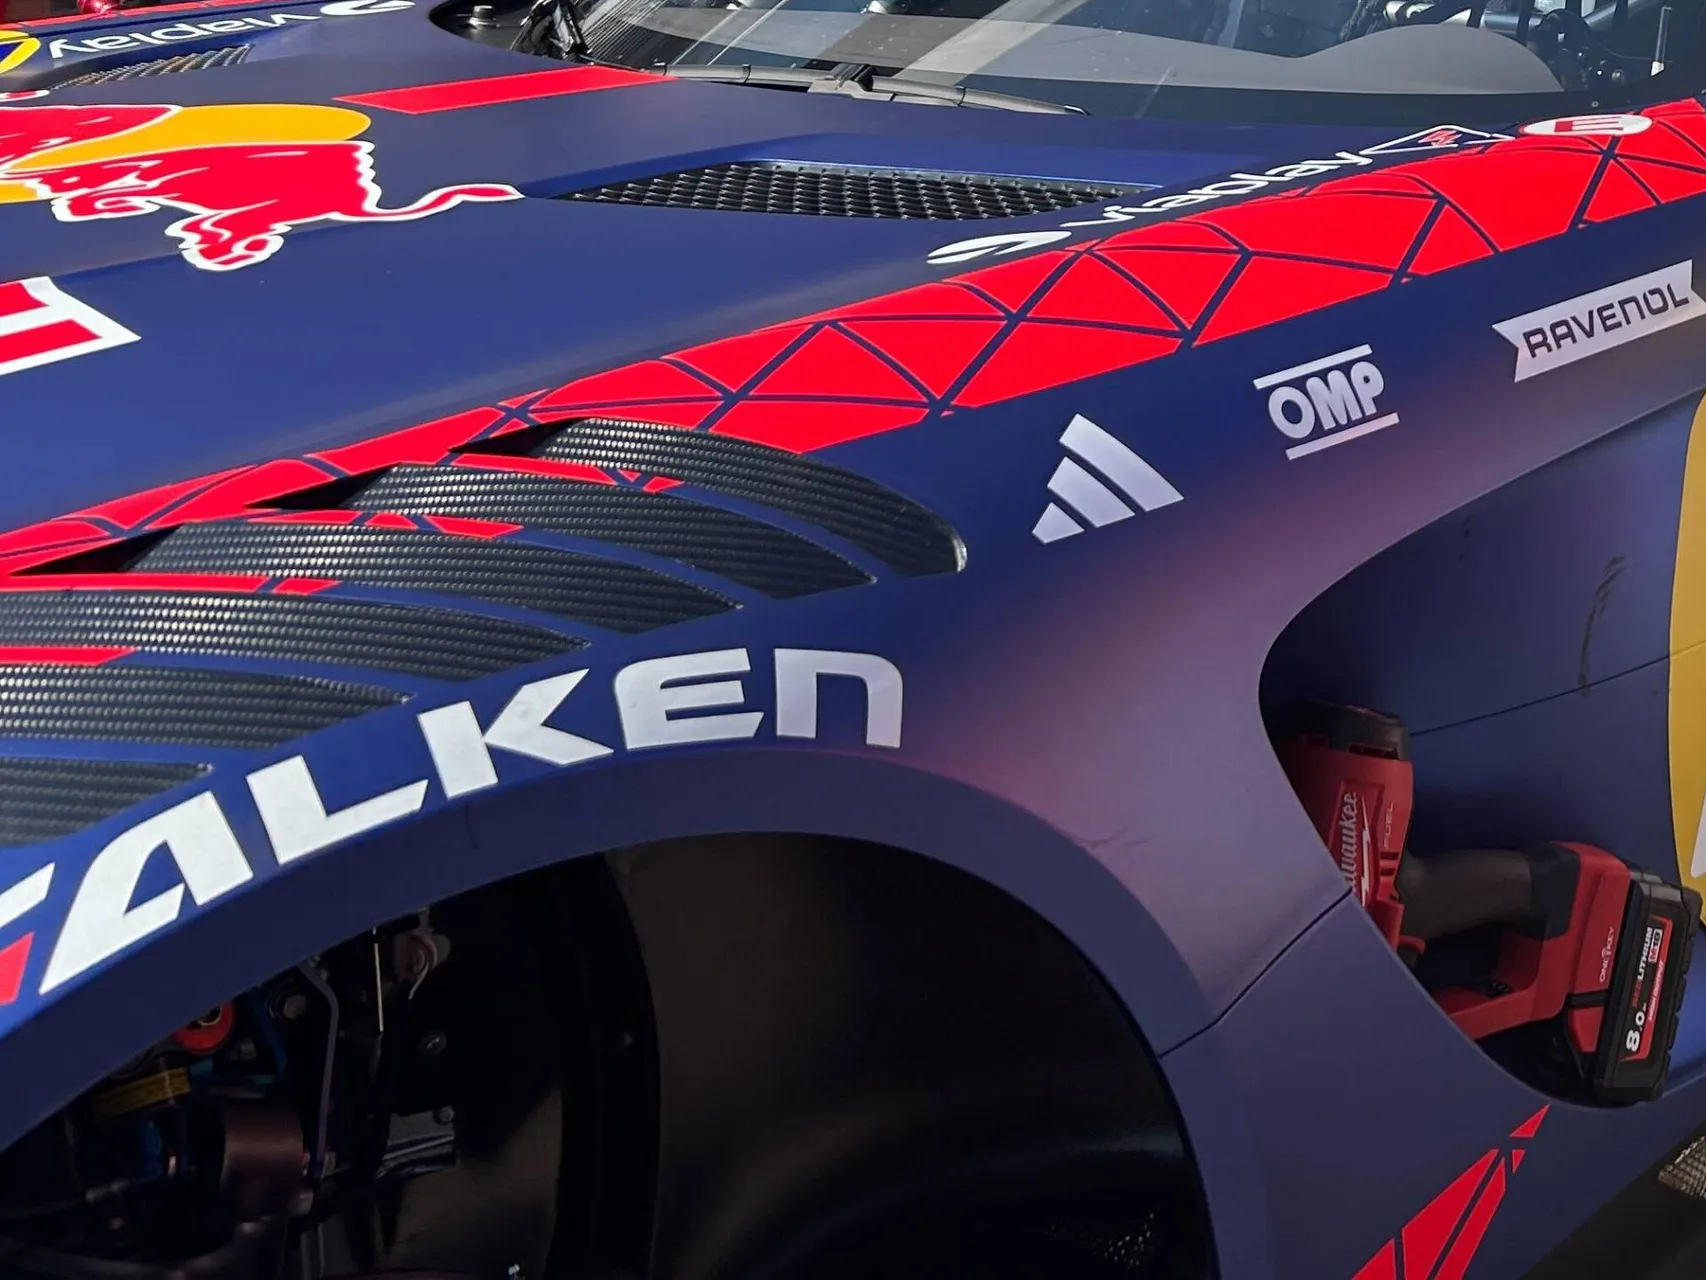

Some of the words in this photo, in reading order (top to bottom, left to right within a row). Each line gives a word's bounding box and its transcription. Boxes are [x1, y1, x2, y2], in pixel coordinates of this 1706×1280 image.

[51, 12, 321, 59] viaplay
[1059, 150, 1374, 227] viaplay
[1522, 282, 1690, 359] RAVENOL
[1267, 360, 1386, 440] OMP
[1626, 1011, 1646, 1052] 8.0
